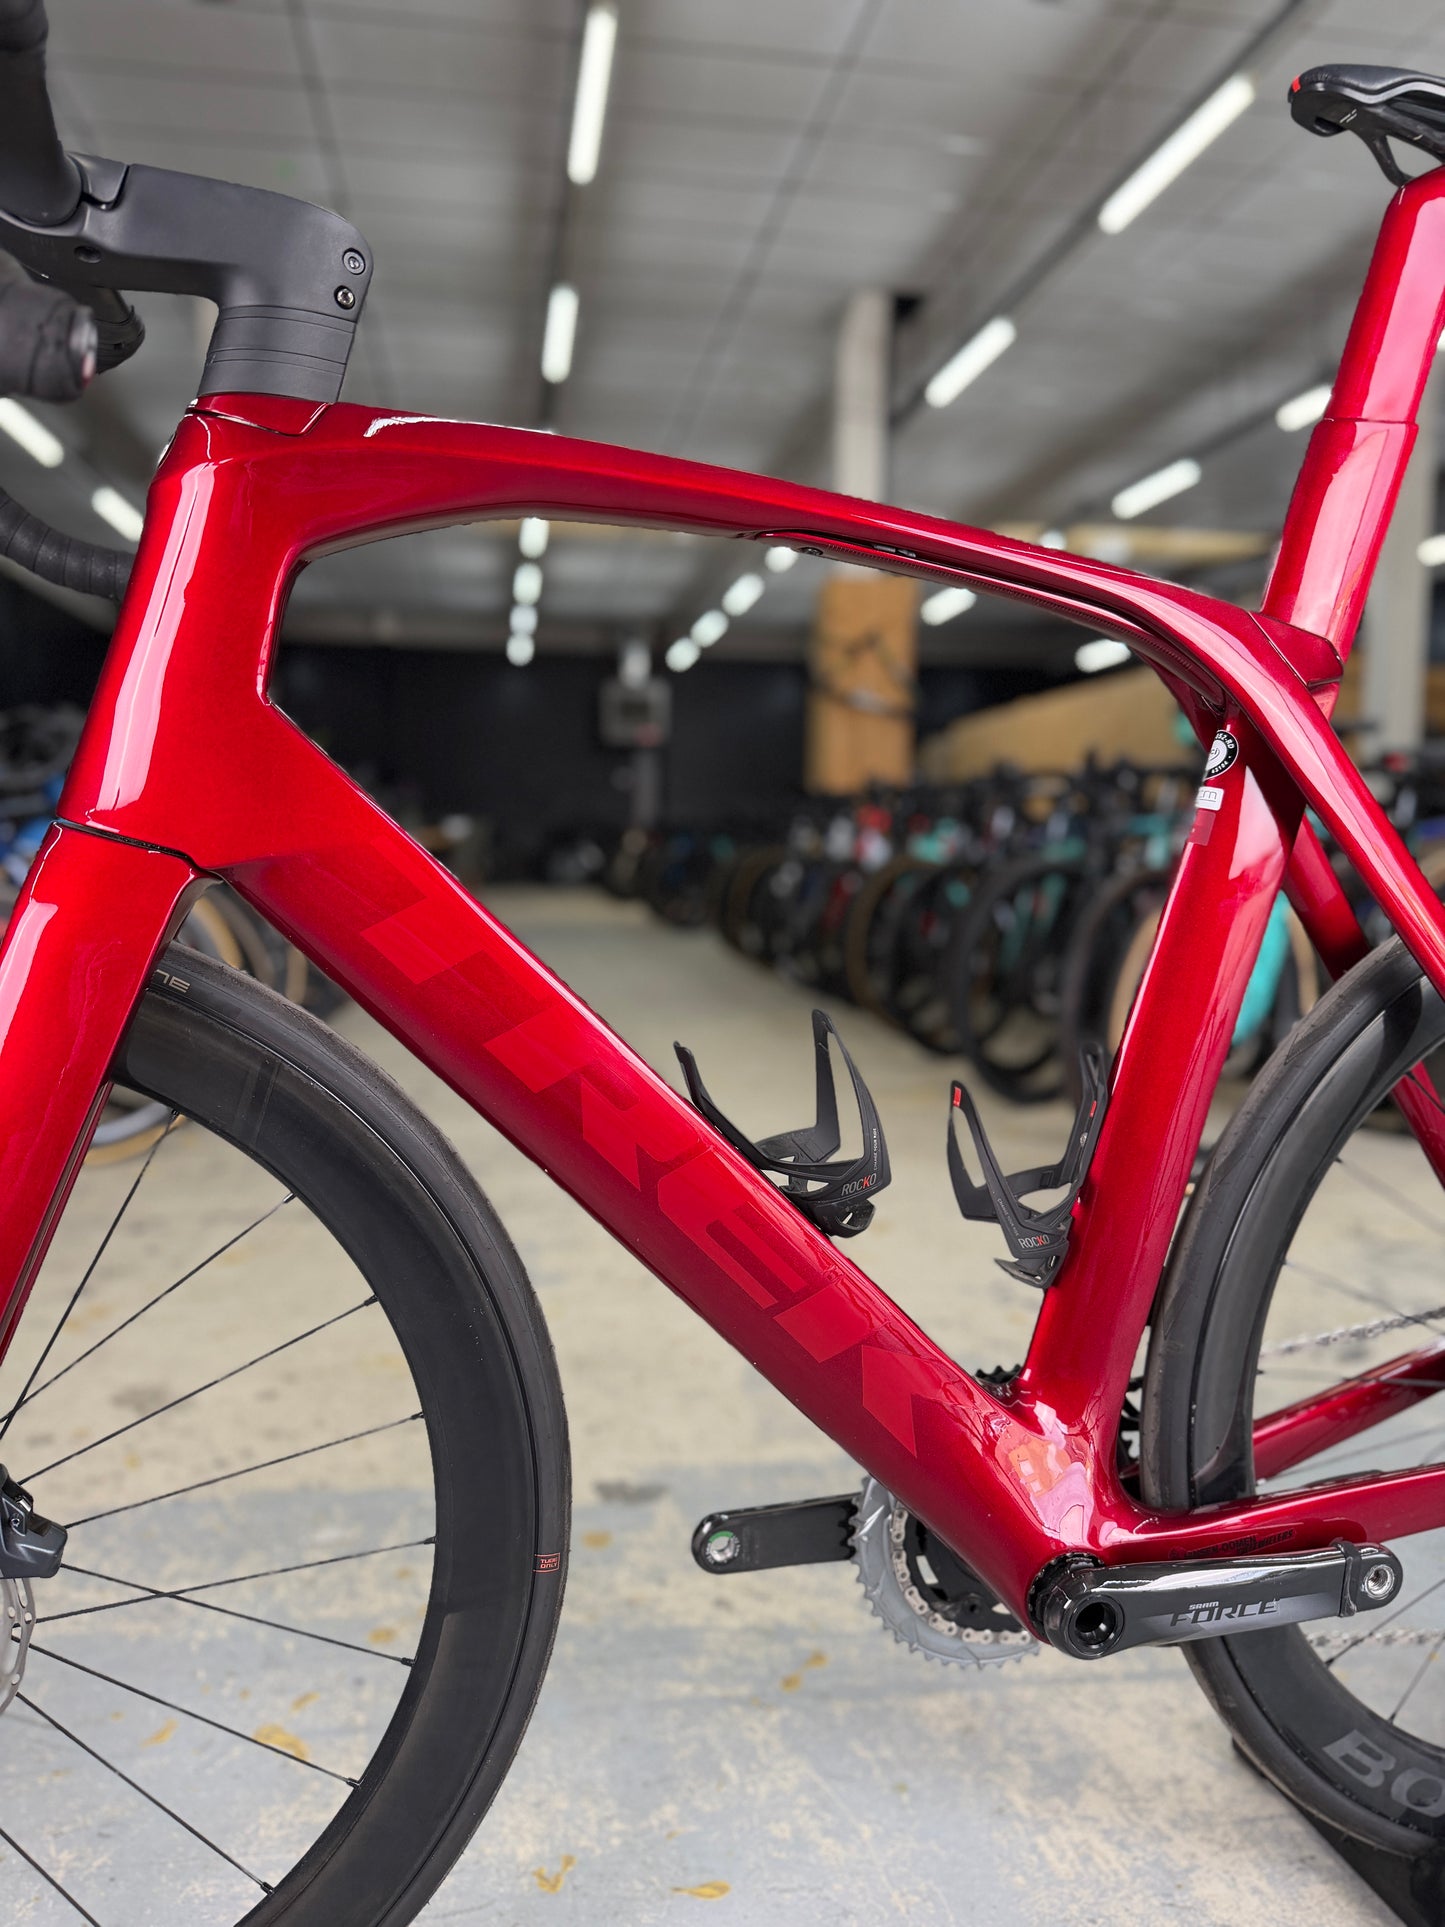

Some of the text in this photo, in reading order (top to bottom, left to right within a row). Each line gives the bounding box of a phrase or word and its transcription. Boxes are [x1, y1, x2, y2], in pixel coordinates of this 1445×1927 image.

[360, 832, 972, 1458] TREK
[841, 1173, 877, 1196] ROCKO
[1017, 1234, 1050, 1249] ROCKO
[1170, 1599, 1279, 1627] FORCE
[1188, 1601, 1219, 1611] SRAM
